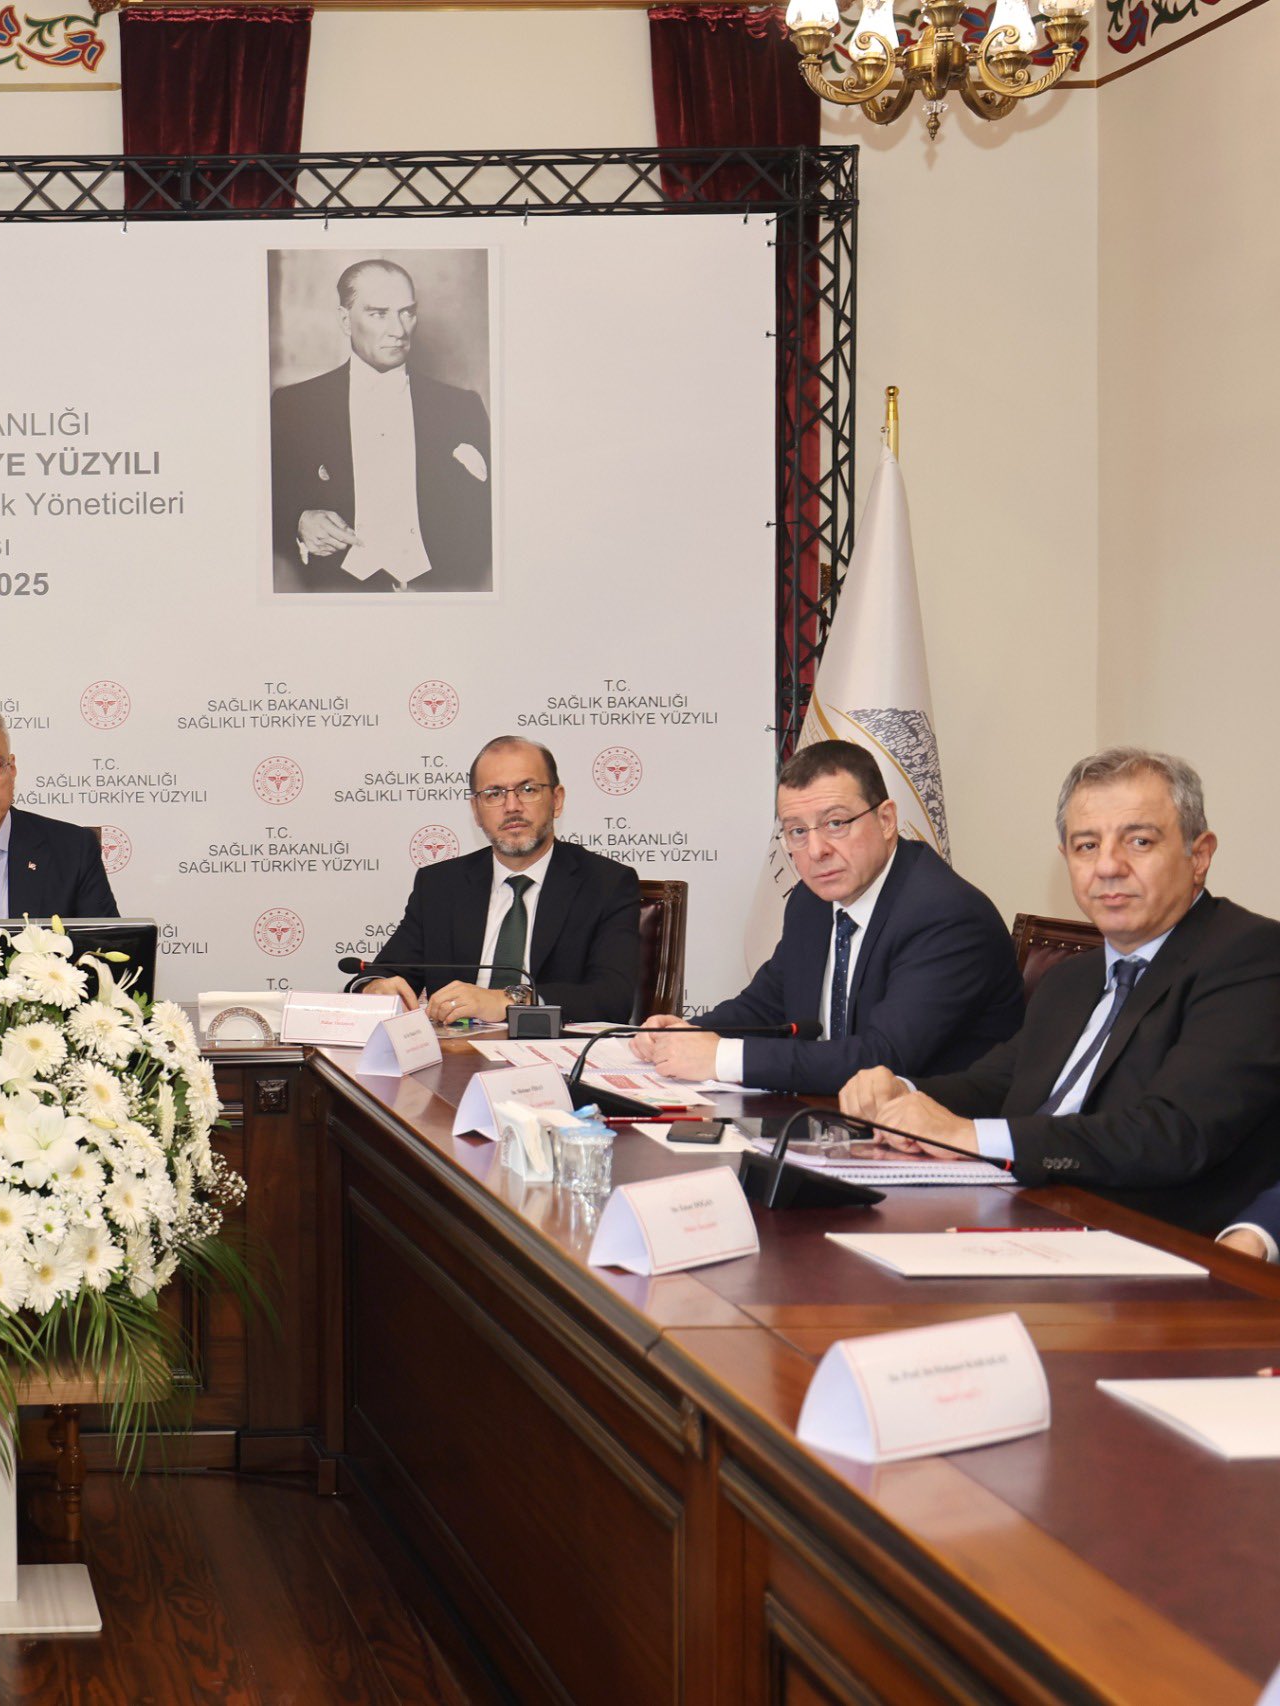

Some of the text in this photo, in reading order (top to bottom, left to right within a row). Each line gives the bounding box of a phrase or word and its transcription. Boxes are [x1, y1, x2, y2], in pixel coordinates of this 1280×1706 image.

[36, 447, 159, 476] YÜZYILI
[25, 491, 183, 515] Yöneticileri
[264, 682, 291, 694] T.C.
[604, 680, 631, 692] T.C.
[208, 696, 348, 712] SAĞLIK BAKANLIĞI
[548, 694, 687, 709] SAĞLIK BAKANLIĞI
[7, 715, 49, 729] ÜZYILI
[178, 713, 378, 729] SAĞLIKLI TÜRKİYE YÜZYILI
[518, 710, 717, 726] SAĞLIKLI TÜRKİYE YÜZYILI
[93, 758, 120, 770] T.C.
[421, 756, 448, 768] T.C.
[36, 772, 176, 787] SAĞLIK BAKANLIĞI
[365, 770, 470, 785] SAĞLIK BAKAN
[78, 790, 144, 803] TÜRKİYE
[149, 789, 206, 803] YÜZYILI
[335, 787, 471, 802] SAĞLIKLI TÜRKİYE
[604, 817, 631, 829] T.C.
[265, 827, 292, 839] T.C.
[560, 831, 687, 847] AĞLIK BAKANLIĞI
[209, 841, 348, 856] SAĞLIK BAKANLIĞI
[660, 848, 717, 861] YÜZYILI
[179, 857, 379, 873] SAĞLIKLI TÜRKİYE YÜZYILI
[266, 978, 293, 990] T.C.
